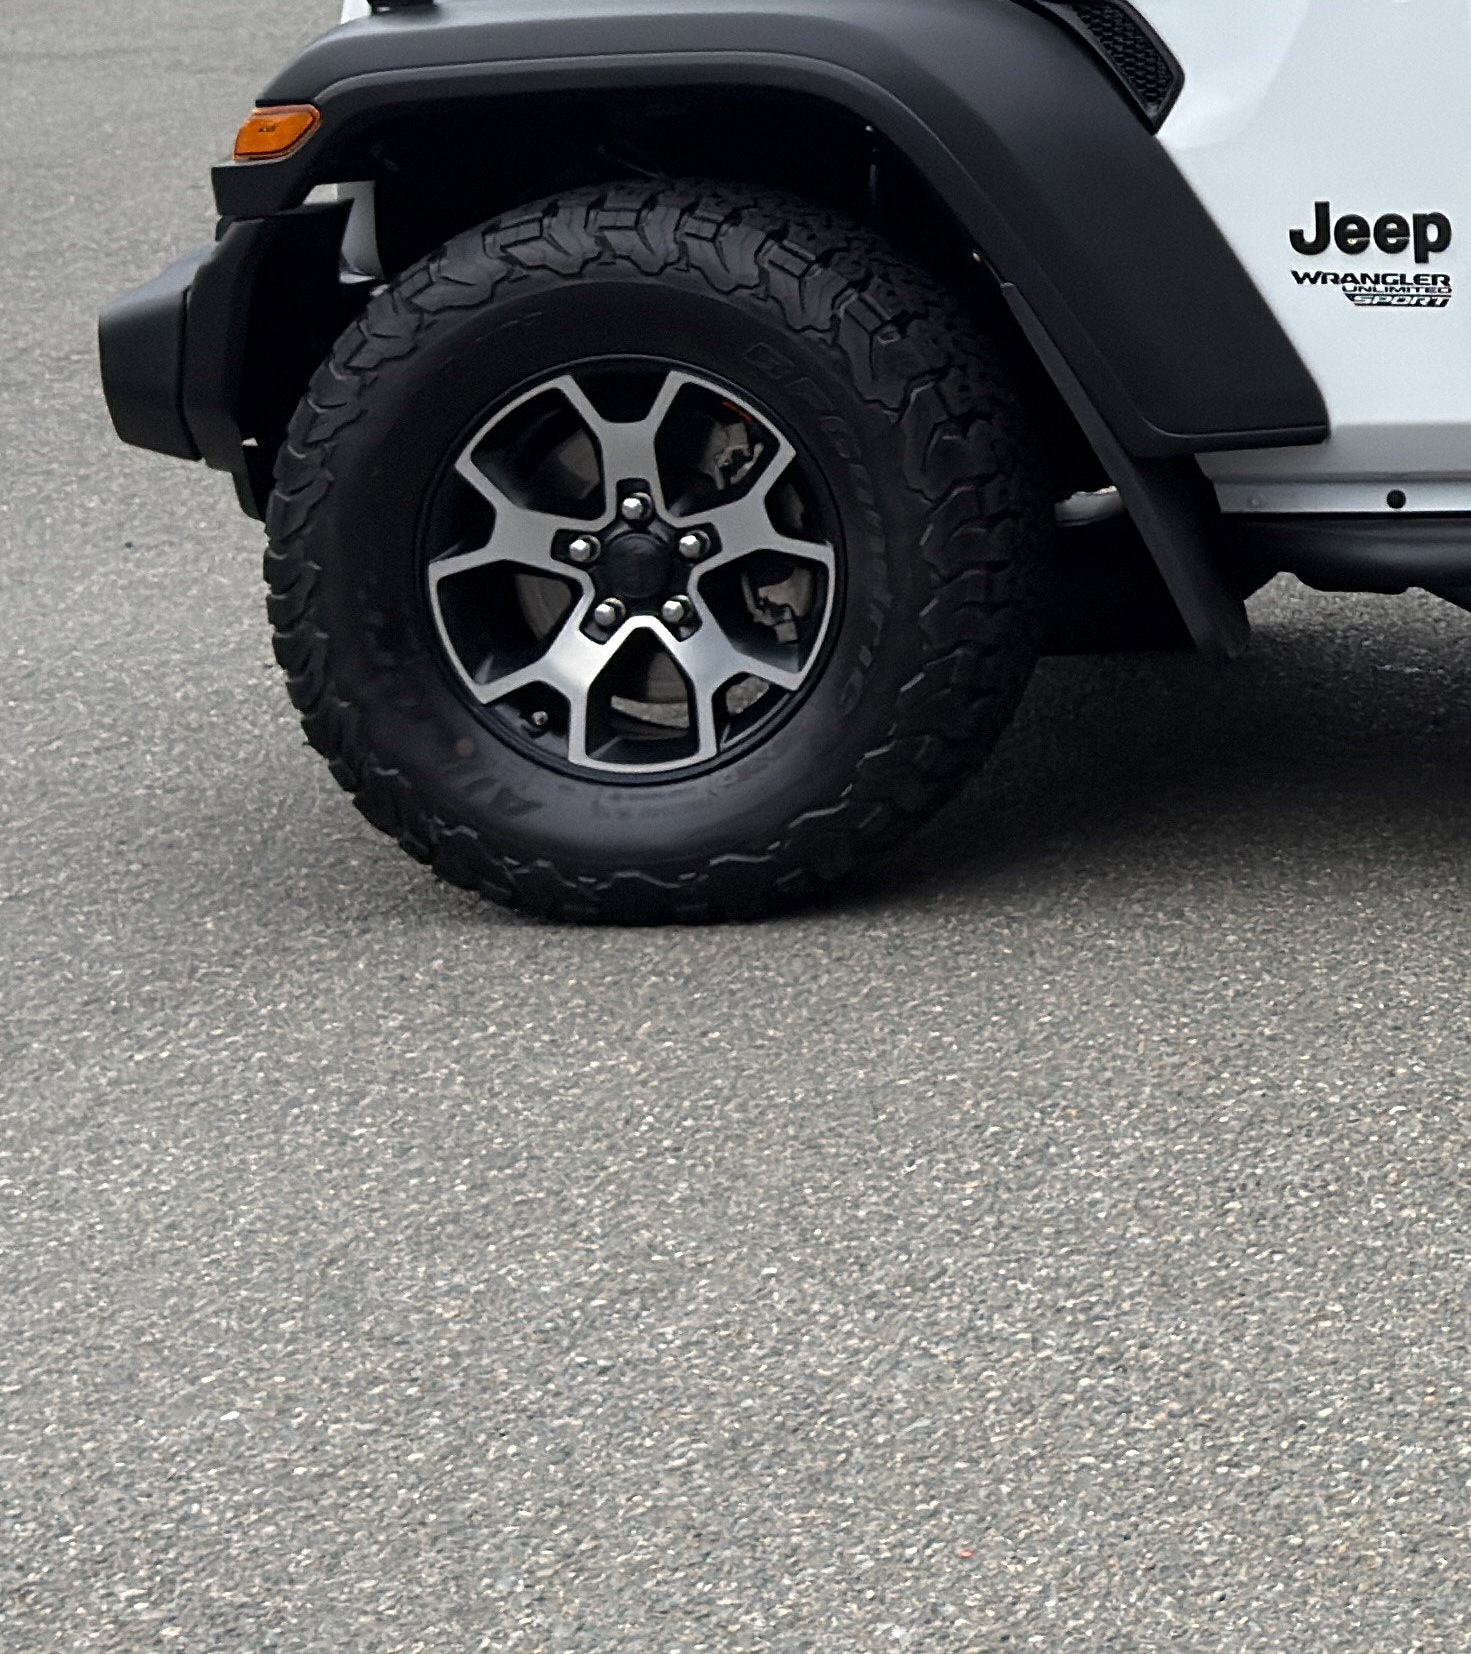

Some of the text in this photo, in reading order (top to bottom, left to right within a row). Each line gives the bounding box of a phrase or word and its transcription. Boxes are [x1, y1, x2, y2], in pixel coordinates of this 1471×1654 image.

[1289, 201, 1452, 263] Jeep
[1290, 270, 1451, 286] WRANGLER
[1342, 285, 1452, 293] UNLIMITED
[1353, 295, 1449, 306] SPORT
